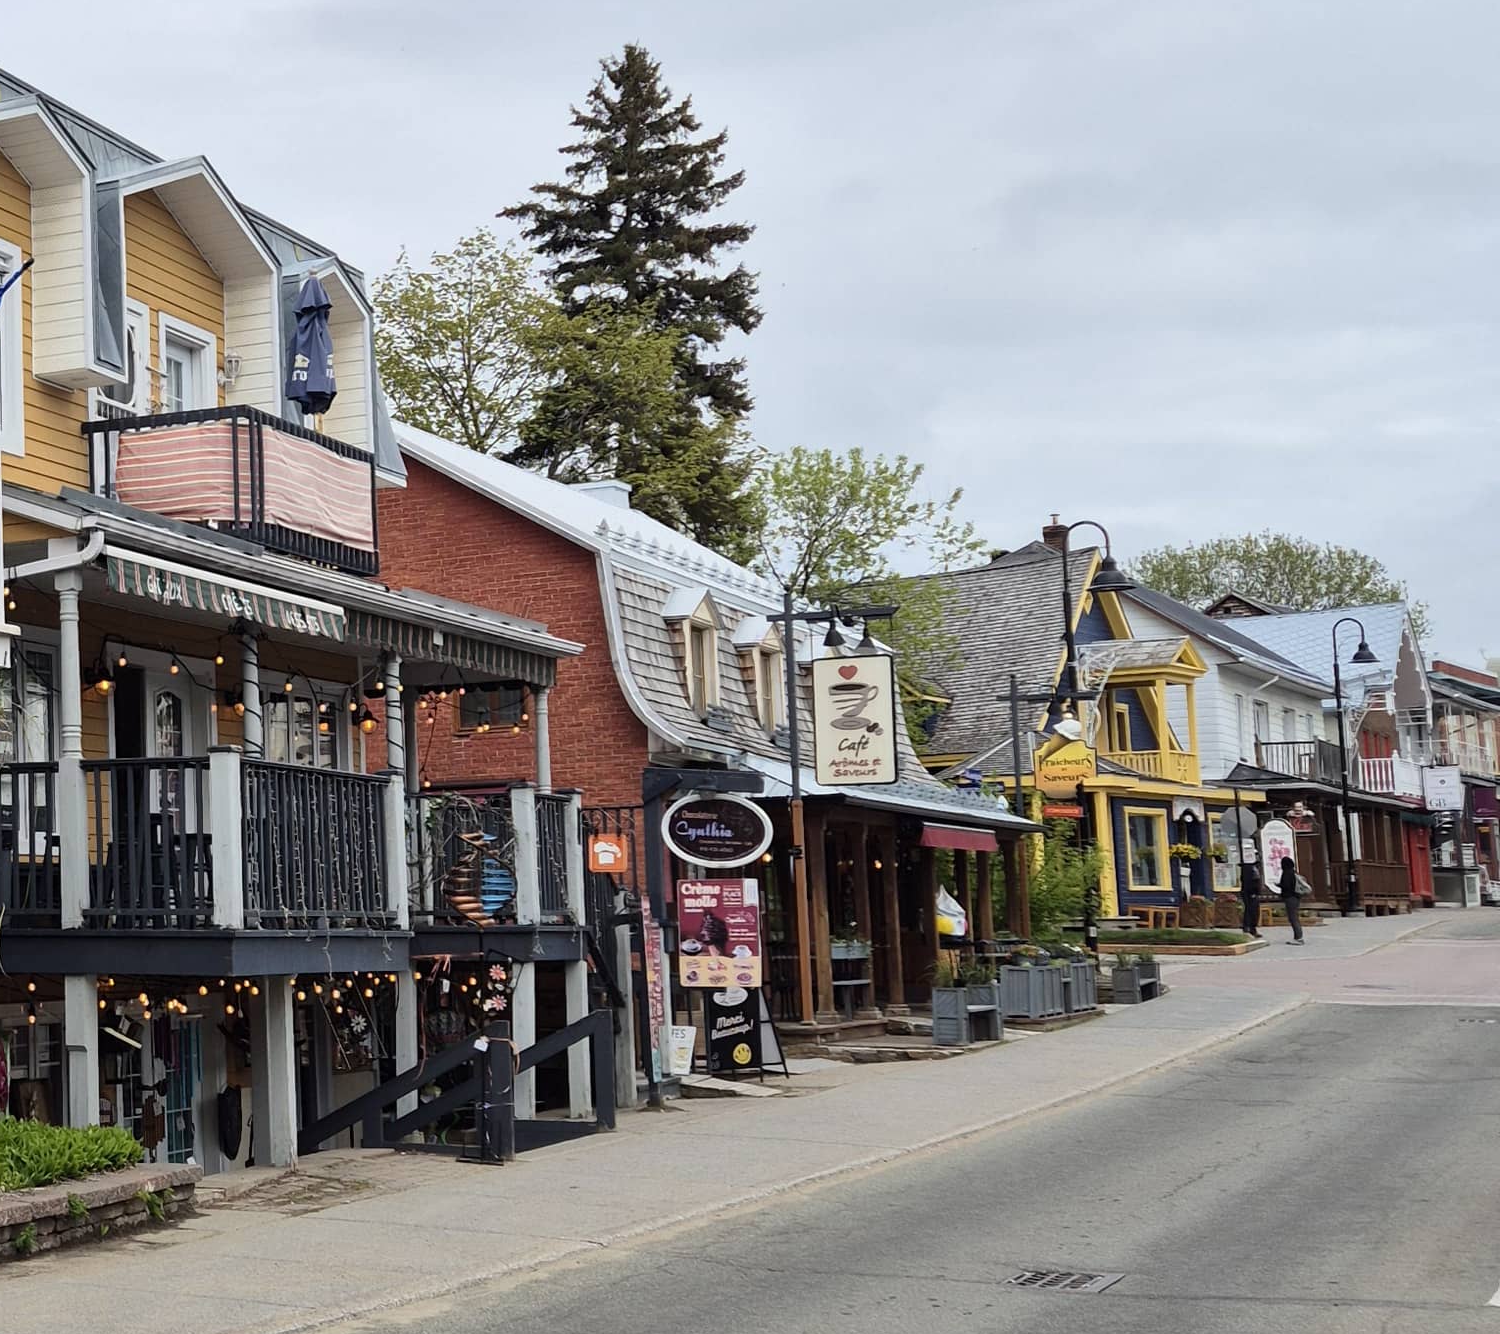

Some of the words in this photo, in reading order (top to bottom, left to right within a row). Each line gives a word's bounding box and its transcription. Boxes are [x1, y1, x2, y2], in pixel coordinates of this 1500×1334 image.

[838, 734, 870, 757] Café
[833, 768, 877, 777] Saveurs
[676, 821, 734, 841] Cynthia
[681, 882, 721, 896] Crème
[684, 895, 718, 908] molle
[716, 1011, 746, 1029] Merci
